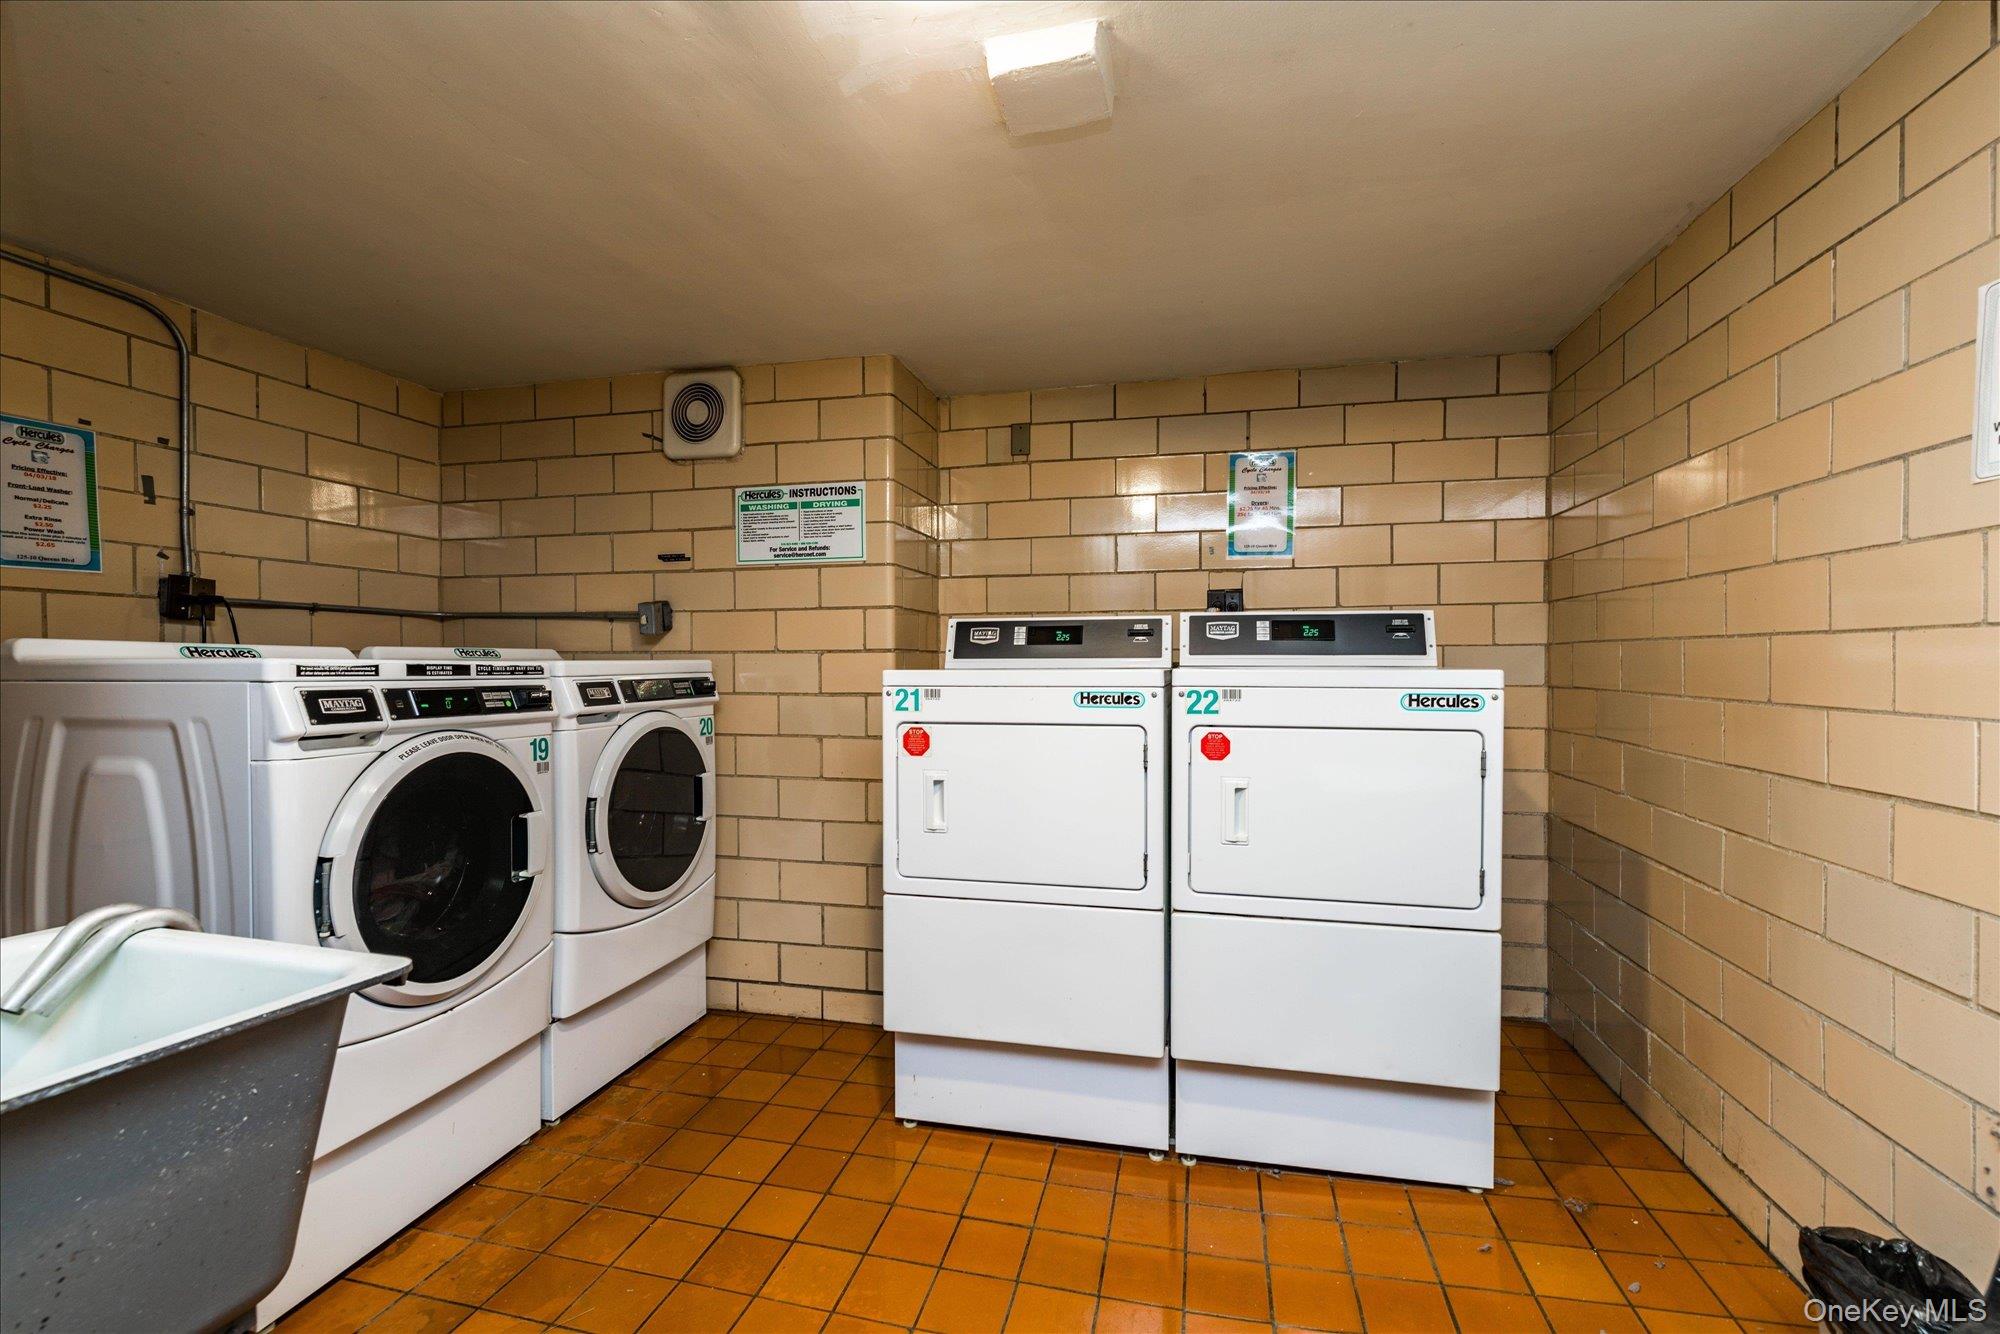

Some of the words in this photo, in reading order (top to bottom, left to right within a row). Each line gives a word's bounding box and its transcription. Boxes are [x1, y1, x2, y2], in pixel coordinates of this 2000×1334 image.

[20, 427, 62, 442] Hercules
[2, 437, 31, 446] Cycle
[35, 442, 75, 454] Charges
[12, 464, 35, 473] Pricing
[14, 494, 69, 506] Normal/Delicate
[744, 490, 781, 500] Hercules
[789, 486, 857, 498] INSTRUCTIONS
[812, 500, 848, 508] DRYING
[186, 646, 256, 658] Hercules
[457, 648, 498, 657] Hercules
[322, 700, 362, 708] MAYTAG
[896, 688, 920, 711] 21
[1080, 692, 1140, 705] Hercules
[1186, 690, 1219, 714] 22
[1408, 694, 1479, 708] Hercules
[700, 718, 712, 736] 20
[398, 745, 422, 760] PLEASE
[421, 738, 441, 748] LEAVE
[530, 738, 549, 761] 19
